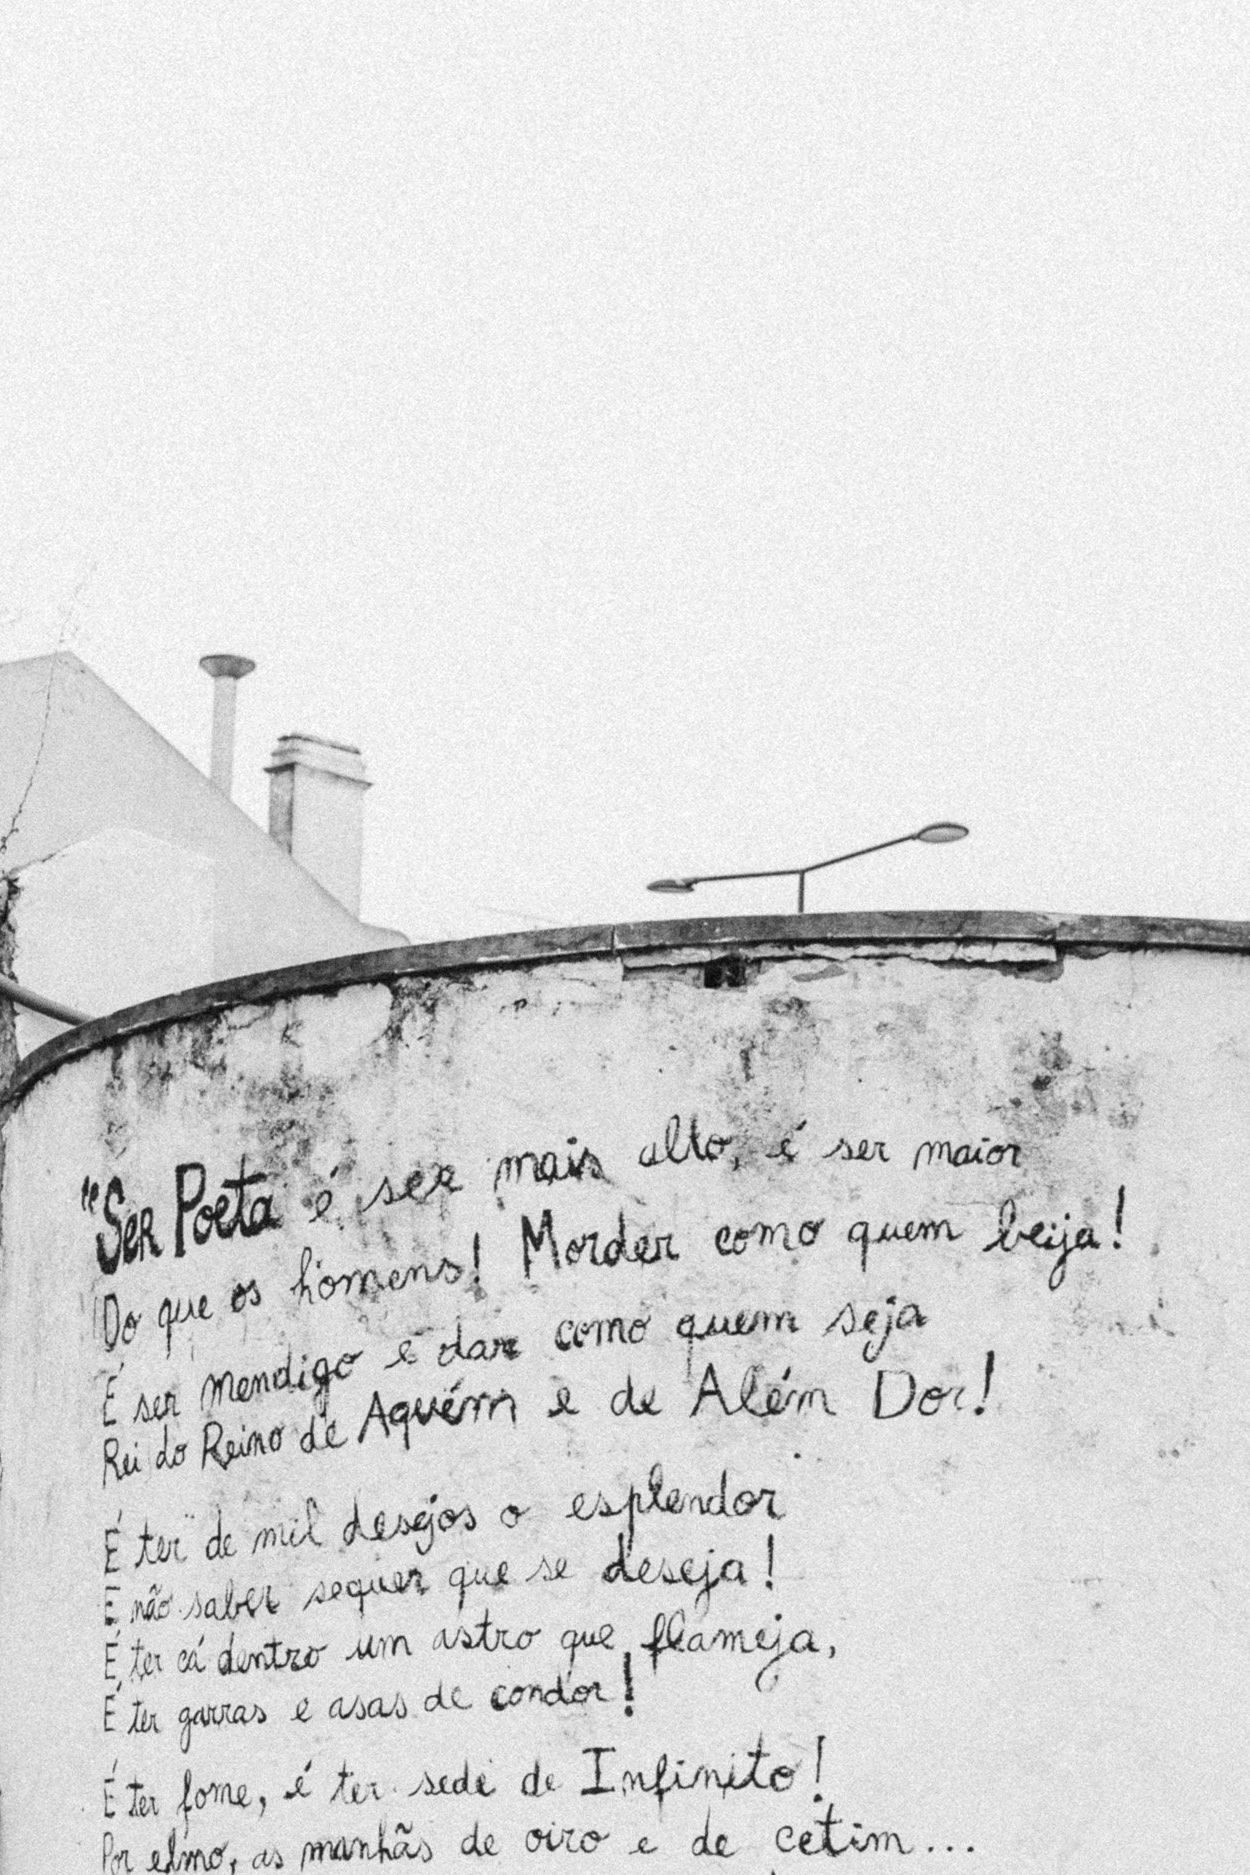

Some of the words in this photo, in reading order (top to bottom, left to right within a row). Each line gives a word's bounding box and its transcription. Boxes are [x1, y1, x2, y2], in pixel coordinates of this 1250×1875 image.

[174, 1154, 284, 1258] Poeta
[362, 1162, 464, 1213] ser
[494, 1136, 614, 1193] mais
[821, 1137, 891, 1163] ser
[911, 1136, 1022, 1171] maior
[102, 1292, 139, 1352] Do
[157, 1295, 214, 1360] que
[230, 1273, 262, 1314] os
[520, 1206, 681, 1280] Morder
[714, 1219, 827, 1256] como
[846, 1218, 964, 1273] quem
[133, 1390, 182, 1424] ser
[200, 1342, 364, 1418] mendigo
[438, 1322, 521, 1367] dar
[554, 1314, 651, 1352] como
[676, 1309, 800, 1384] quem
[821, 1295, 929, 1363] seja
[103, 1436, 142, 1490] Rei
[156, 1423, 188, 1470] do
[200, 1419, 286, 1470] Reino
[300, 1413, 349, 1454] de
[358, 1375, 518, 1451] Aquém
[546, 1385, 581, 1419] e
[610, 1372, 663, 1416] de
[689, 1361, 837, 1419] Além
[873, 1349, 996, 1420] Dor!
[134, 1518, 189, 1569] ter
[205, 1506, 238, 1562] de
[252, 1495, 324, 1556] mil
[499, 1503, 532, 1529] o
[565, 1462, 787, 1557] esplendor
[130, 1583, 172, 1624] não
[302, 1567, 430, 1619] sequer
[449, 1560, 511, 1611] que
[524, 1554, 575, 1583] se
[129, 1637, 165, 1680] ter
[176, 1633, 208, 1674] cá
[217, 1631, 330, 1677] dentro
[344, 1632, 413, 1663] um
[432, 1607, 544, 1653] astro
[559, 1623, 617, 1682] que
[126, 1698, 163, 1735] ter
[177, 1701, 268, 1755] garras
[289, 1696, 314, 1723] e
[328, 1691, 410, 1722] asas
[423, 1679, 474, 1713] de
[126, 1772, 162, 1818] ter
[283, 1759, 314, 1801] é
[331, 1759, 385, 1805] ter
[407, 1757, 498, 1798] sede
[520, 1758, 564, 1799] de
[252, 1847, 285, 1873] as
[301, 1812, 435, 1873] manhãs
[460, 1818, 501, 1858] de
[524, 1821, 611, 1856] oiro
[628, 1834, 660, 1857] e
[691, 1805, 737, 1859] de
